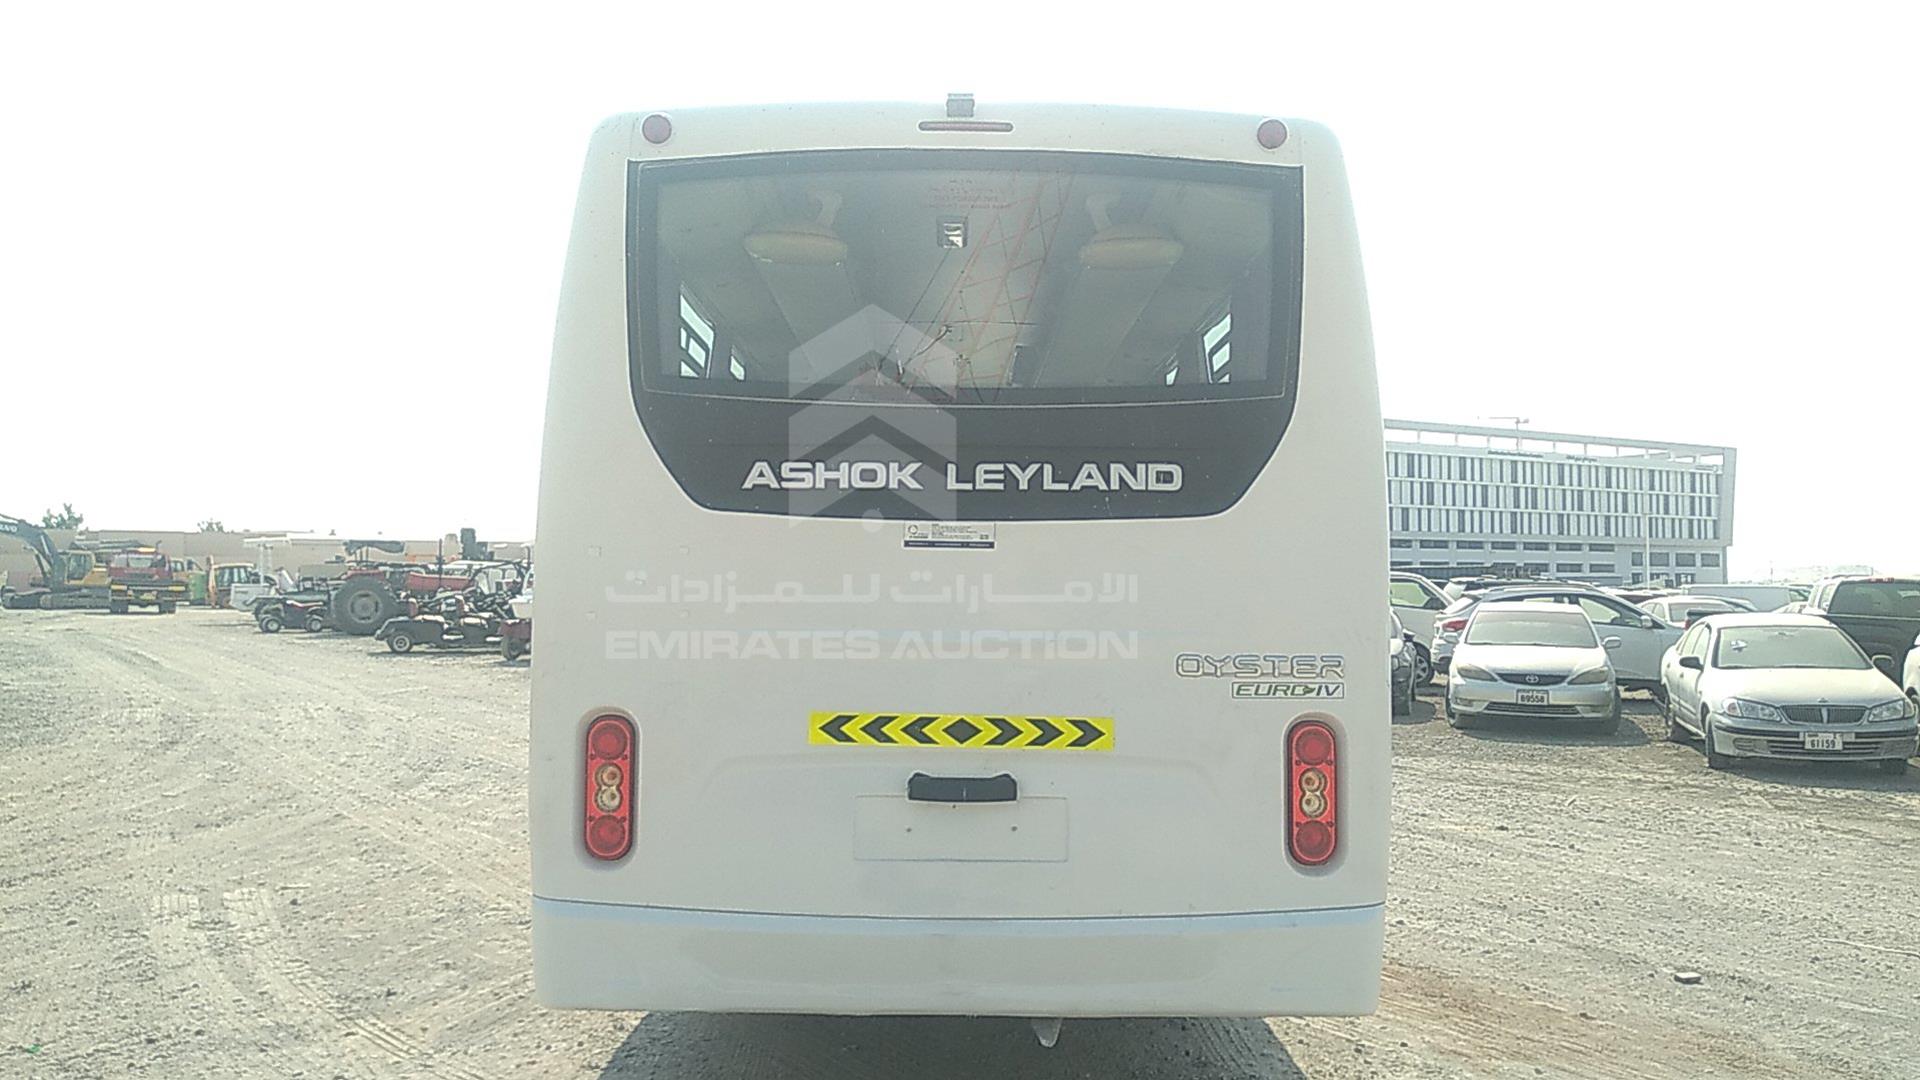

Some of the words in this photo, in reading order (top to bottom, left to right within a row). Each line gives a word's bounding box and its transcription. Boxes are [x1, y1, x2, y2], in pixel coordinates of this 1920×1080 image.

[741, 461, 924, 490] ASHOK
[946, 463, 1184, 491] LEYLAND
[1176, 653, 1344, 679] OYSTER
[1810, 739, 1836, 748] 61159
